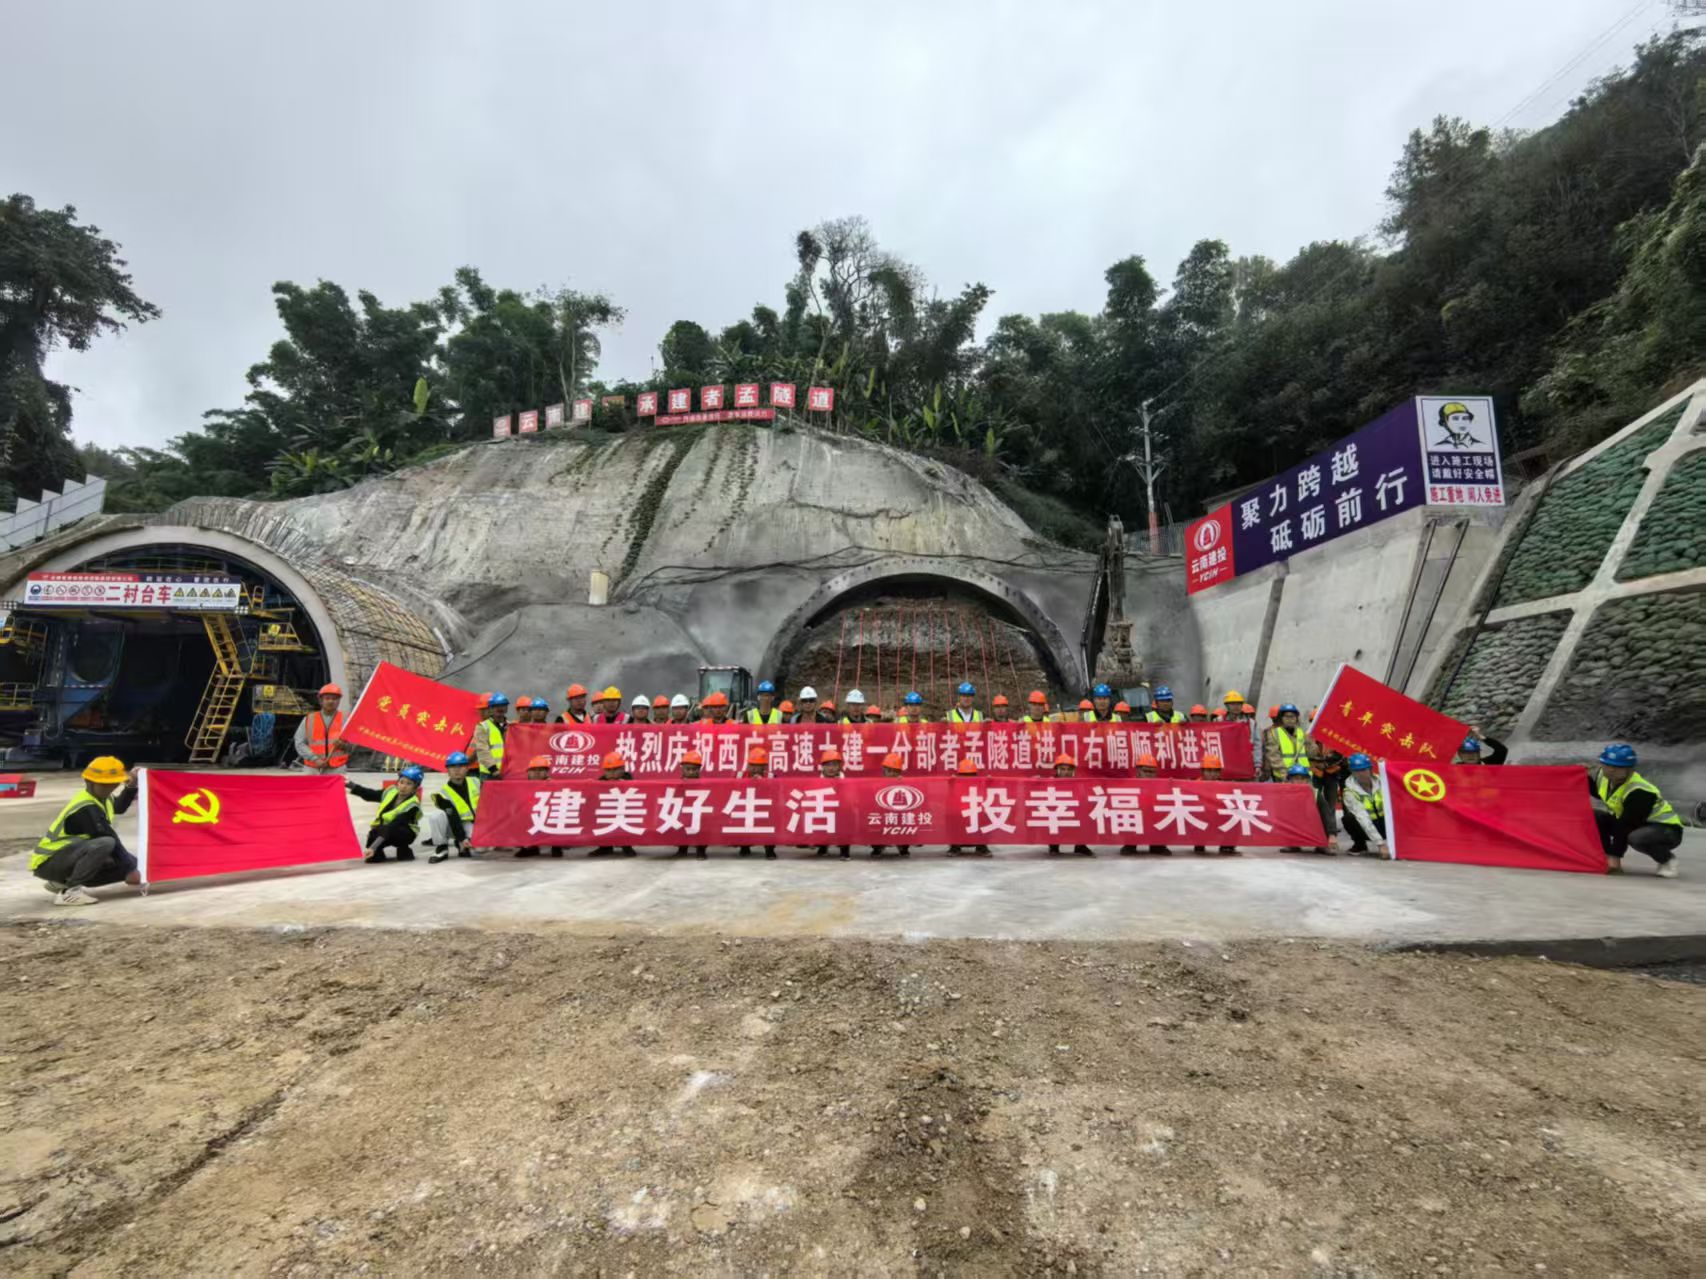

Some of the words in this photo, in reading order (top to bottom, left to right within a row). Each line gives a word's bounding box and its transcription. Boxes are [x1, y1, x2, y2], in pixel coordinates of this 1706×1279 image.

[1430, 455, 1494, 467] 进入施工现场
[1432, 468, 1495, 479] 请戴好安全帽
[1241, 443, 1359, 530] 聚力跨越
[1270, 467, 1408, 553] 砥砺前行
[1192, 545, 1227, 574] 云南建投
[377, 695, 465, 737] 党员突击队
[1340, 700, 1437, 760] 青年突击队
[551, 766, 586, 774] YCIH
[528, 787, 840, 836] 建美好生活
[867, 812, 933, 825] 云南建投
[961, 786, 1273, 836] 投幸福未来
[882, 826, 918, 835] YCIH
